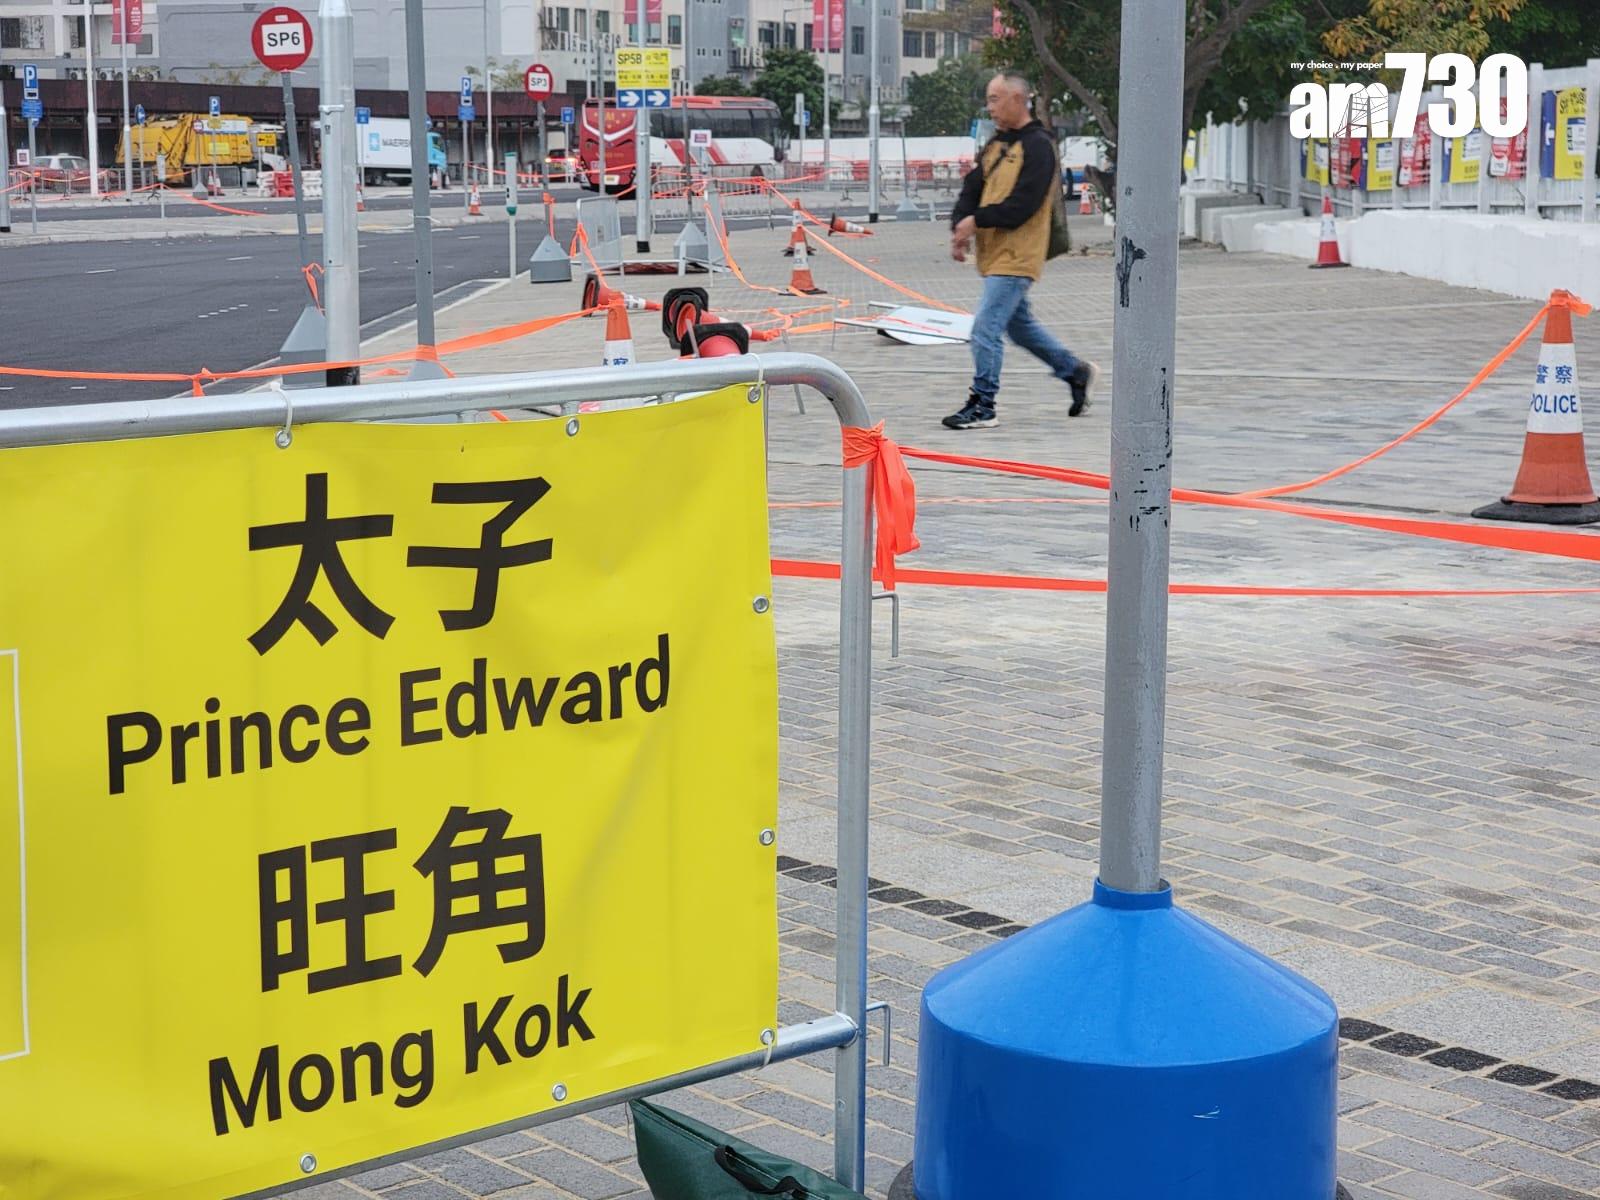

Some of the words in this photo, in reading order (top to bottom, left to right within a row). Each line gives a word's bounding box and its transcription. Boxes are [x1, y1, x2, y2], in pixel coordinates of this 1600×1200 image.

[267, 31, 301, 47] SP6
[617, 53, 642, 65] SP5B
[247, 472, 553, 656] 太子
[106, 697, 371, 795] Prince
[399, 634, 670, 747] Edward
[258, 806, 547, 994] 旺角
[208, 1028, 434, 1137] Mong
[463, 974, 595, 1075] Kok
